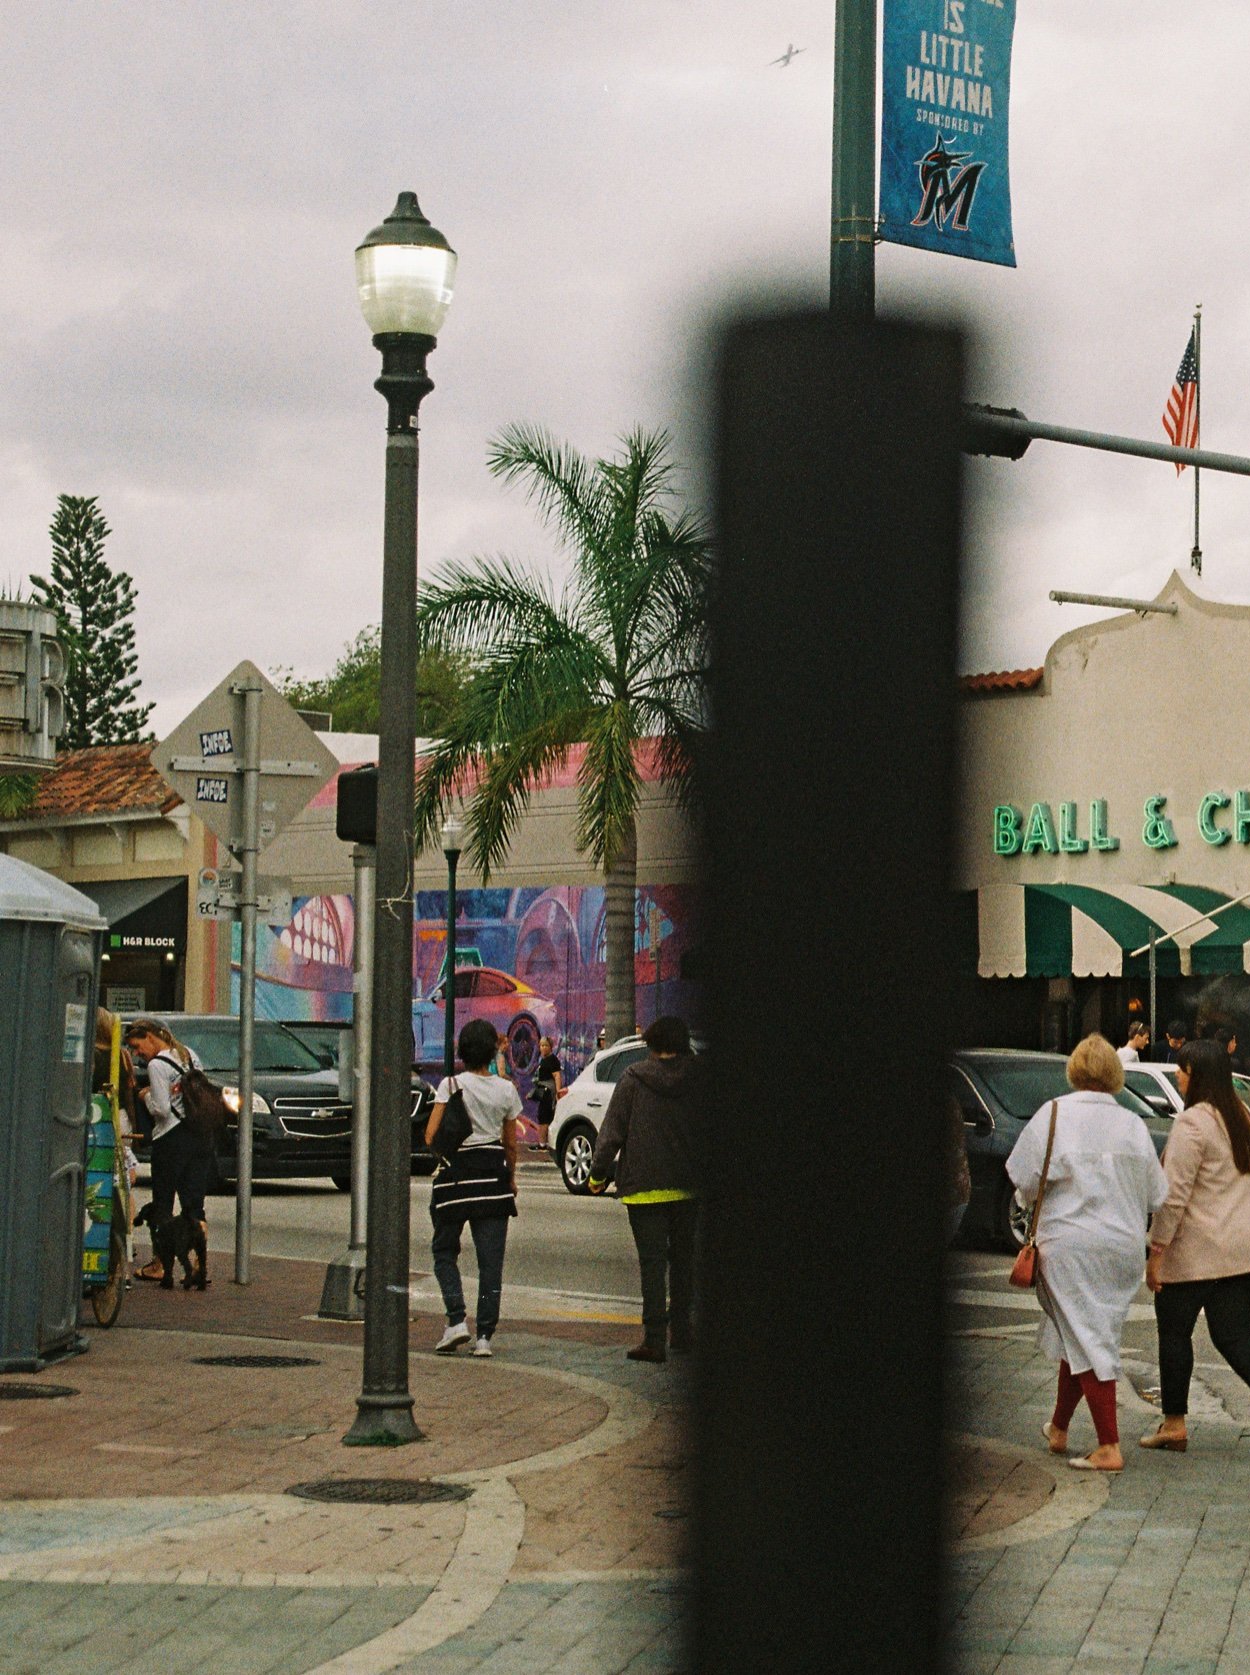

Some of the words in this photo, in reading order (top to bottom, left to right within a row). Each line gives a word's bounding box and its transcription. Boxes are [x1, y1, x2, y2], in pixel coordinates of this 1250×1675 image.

[944, 0, 965, 34] IS
[920, 30, 984, 78] LITTLE
[906, 65, 993, 119] HAVANA
[916, 108, 970, 134] SPONSORED
[973, 120, 984, 135] BY
[993, 797, 1120, 856] BALL
[1142, 794, 1179, 849] &
[123, 936, 143, 946] H&R
[144, 936, 175, 947] BLOCK
